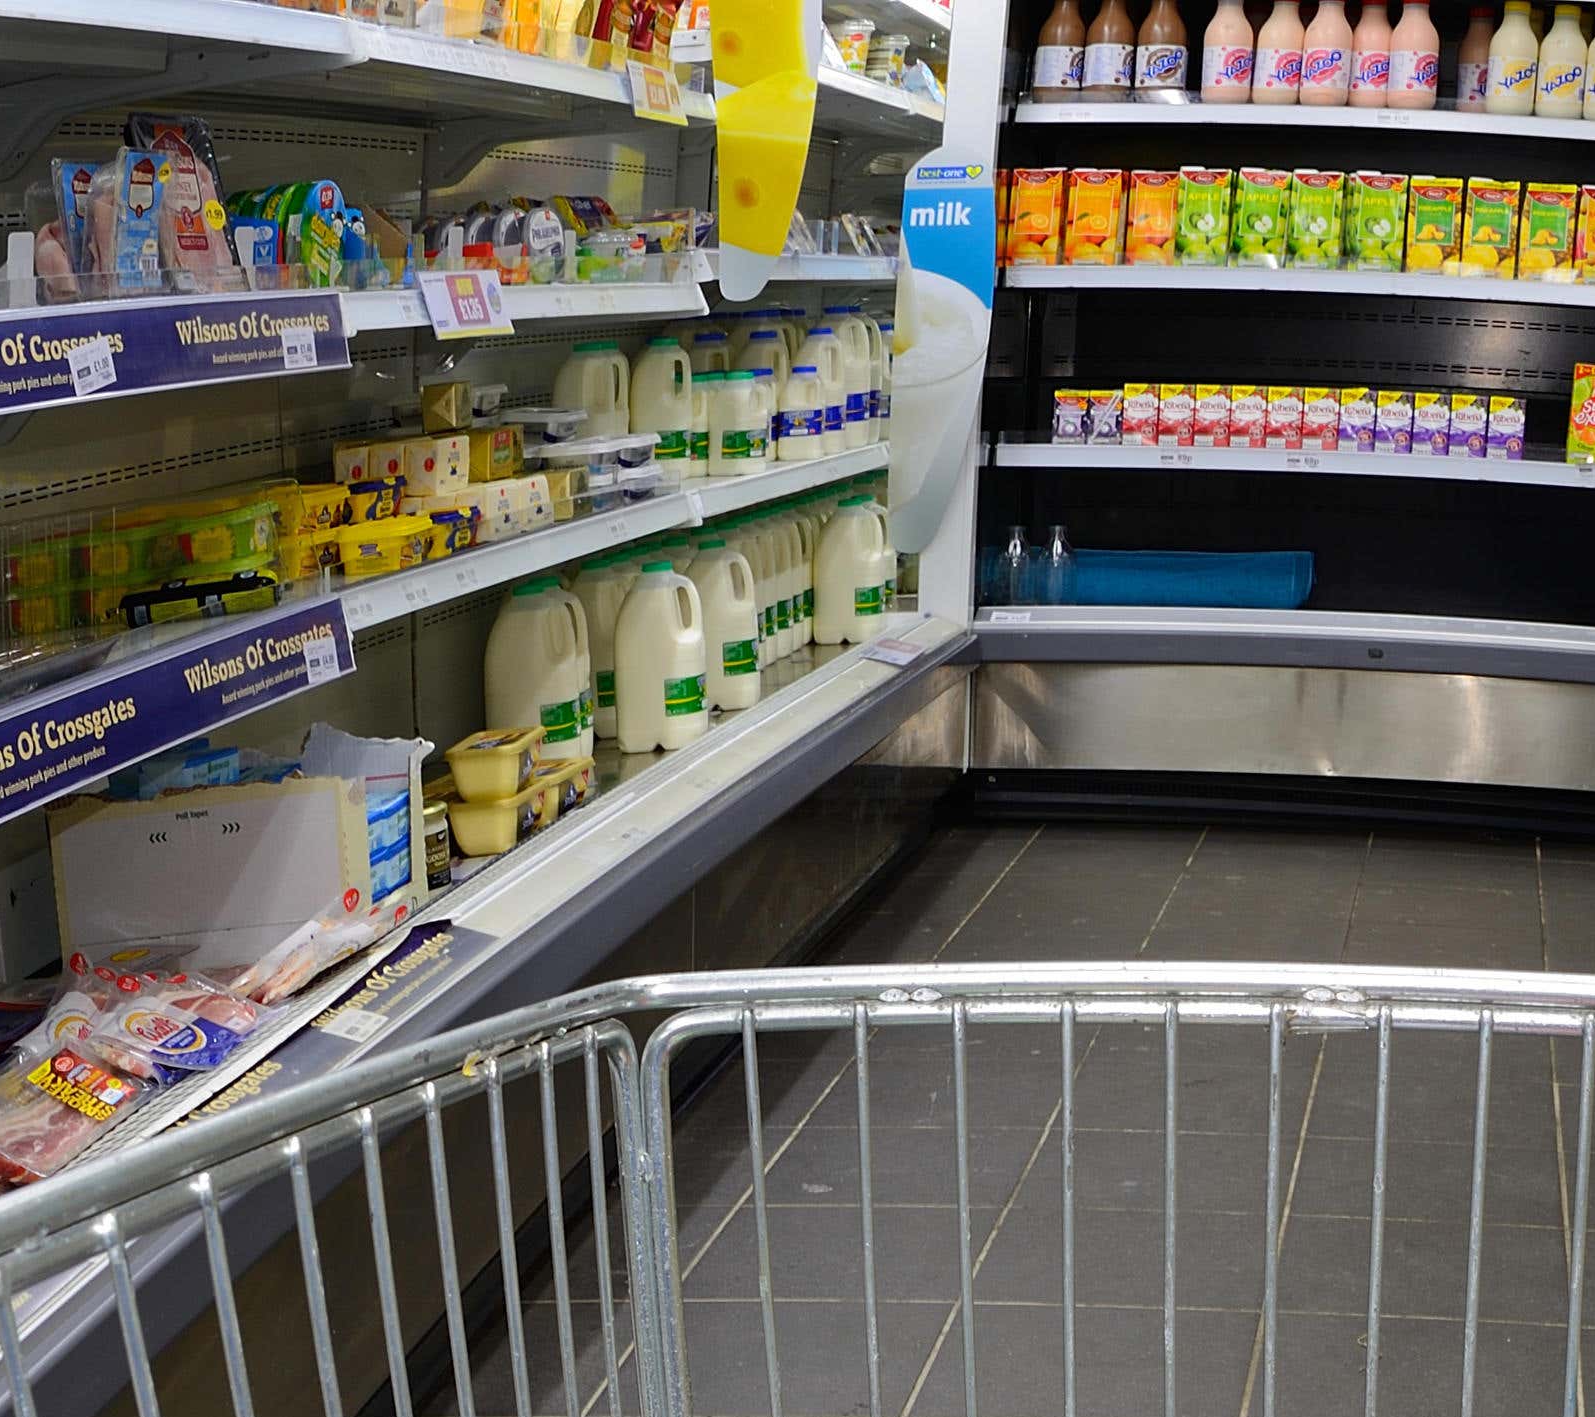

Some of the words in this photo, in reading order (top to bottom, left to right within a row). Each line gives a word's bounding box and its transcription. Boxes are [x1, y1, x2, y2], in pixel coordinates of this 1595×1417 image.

[920, 167, 965, 179] best-one
[1188, 192, 1218, 201] APPLE
[909, 202, 972, 227] milk
[17, 733, 43, 765] Of
[44, 694, 137, 754] Crossgates
